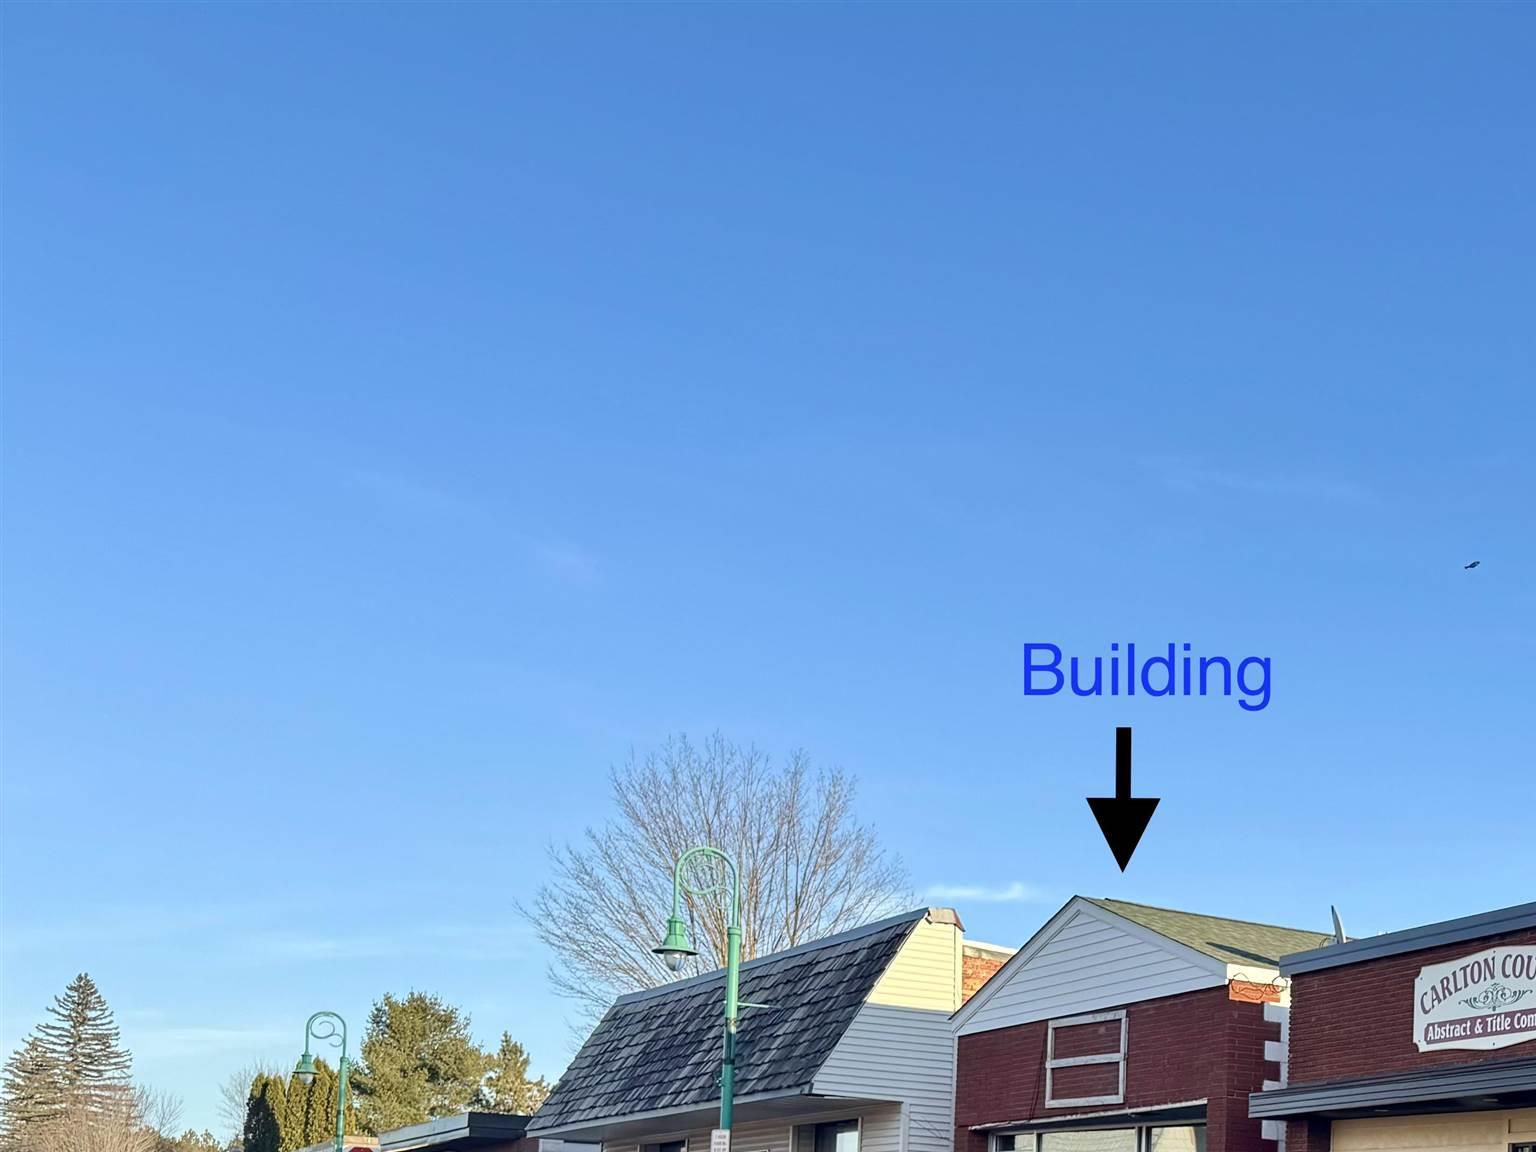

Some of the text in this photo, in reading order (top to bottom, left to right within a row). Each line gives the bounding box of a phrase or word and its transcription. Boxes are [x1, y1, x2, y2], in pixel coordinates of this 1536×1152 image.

[1420, 956, 1496, 1015] CARLTON
[1427, 1022, 1471, 1041] Abstract
[1474, 1018, 1484, 1034] &
[1486, 1013, 1511, 1033] Title
